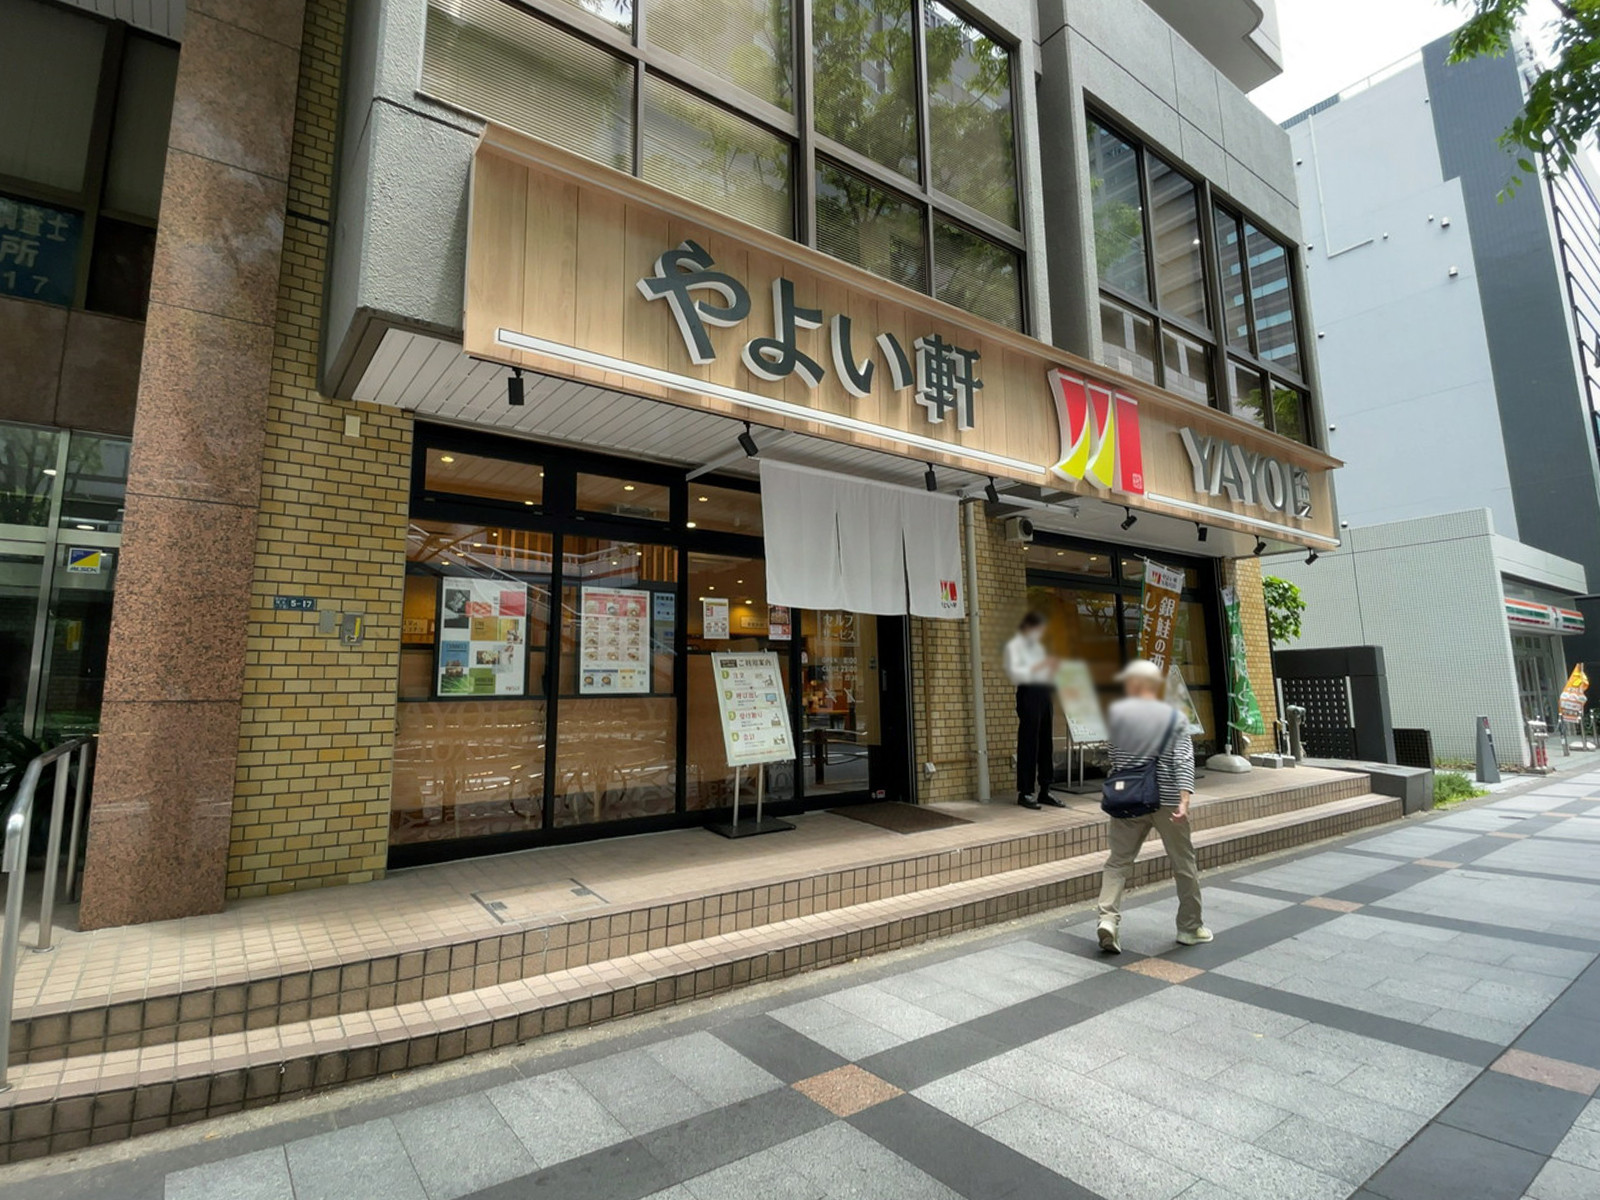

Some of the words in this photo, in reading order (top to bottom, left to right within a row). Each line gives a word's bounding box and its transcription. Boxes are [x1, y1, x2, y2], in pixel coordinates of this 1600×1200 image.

[636, 239, 984, 431] やよい軒
[1180, 427, 1298, 517] YAYOI
[290, 599, 312, 608] 5-17
[822, 613, 853, 628] セルフ
